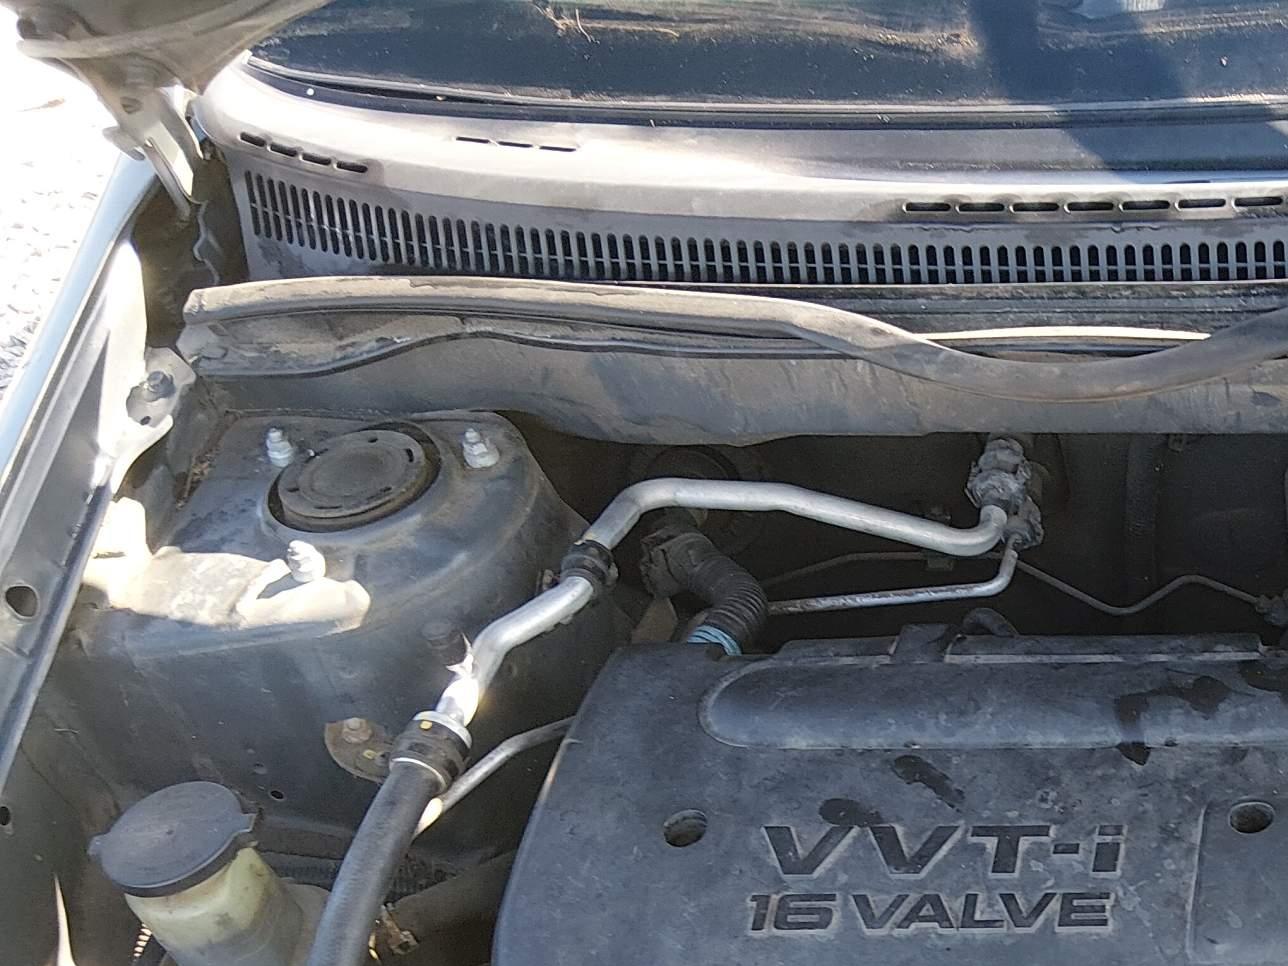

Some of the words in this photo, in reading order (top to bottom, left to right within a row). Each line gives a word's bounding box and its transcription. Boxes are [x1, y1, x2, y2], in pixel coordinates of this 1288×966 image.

[762, 824, 1125, 878] VVT-i
[749, 893, 837, 935] 16
[850, 891, 1115, 934] VALVE
